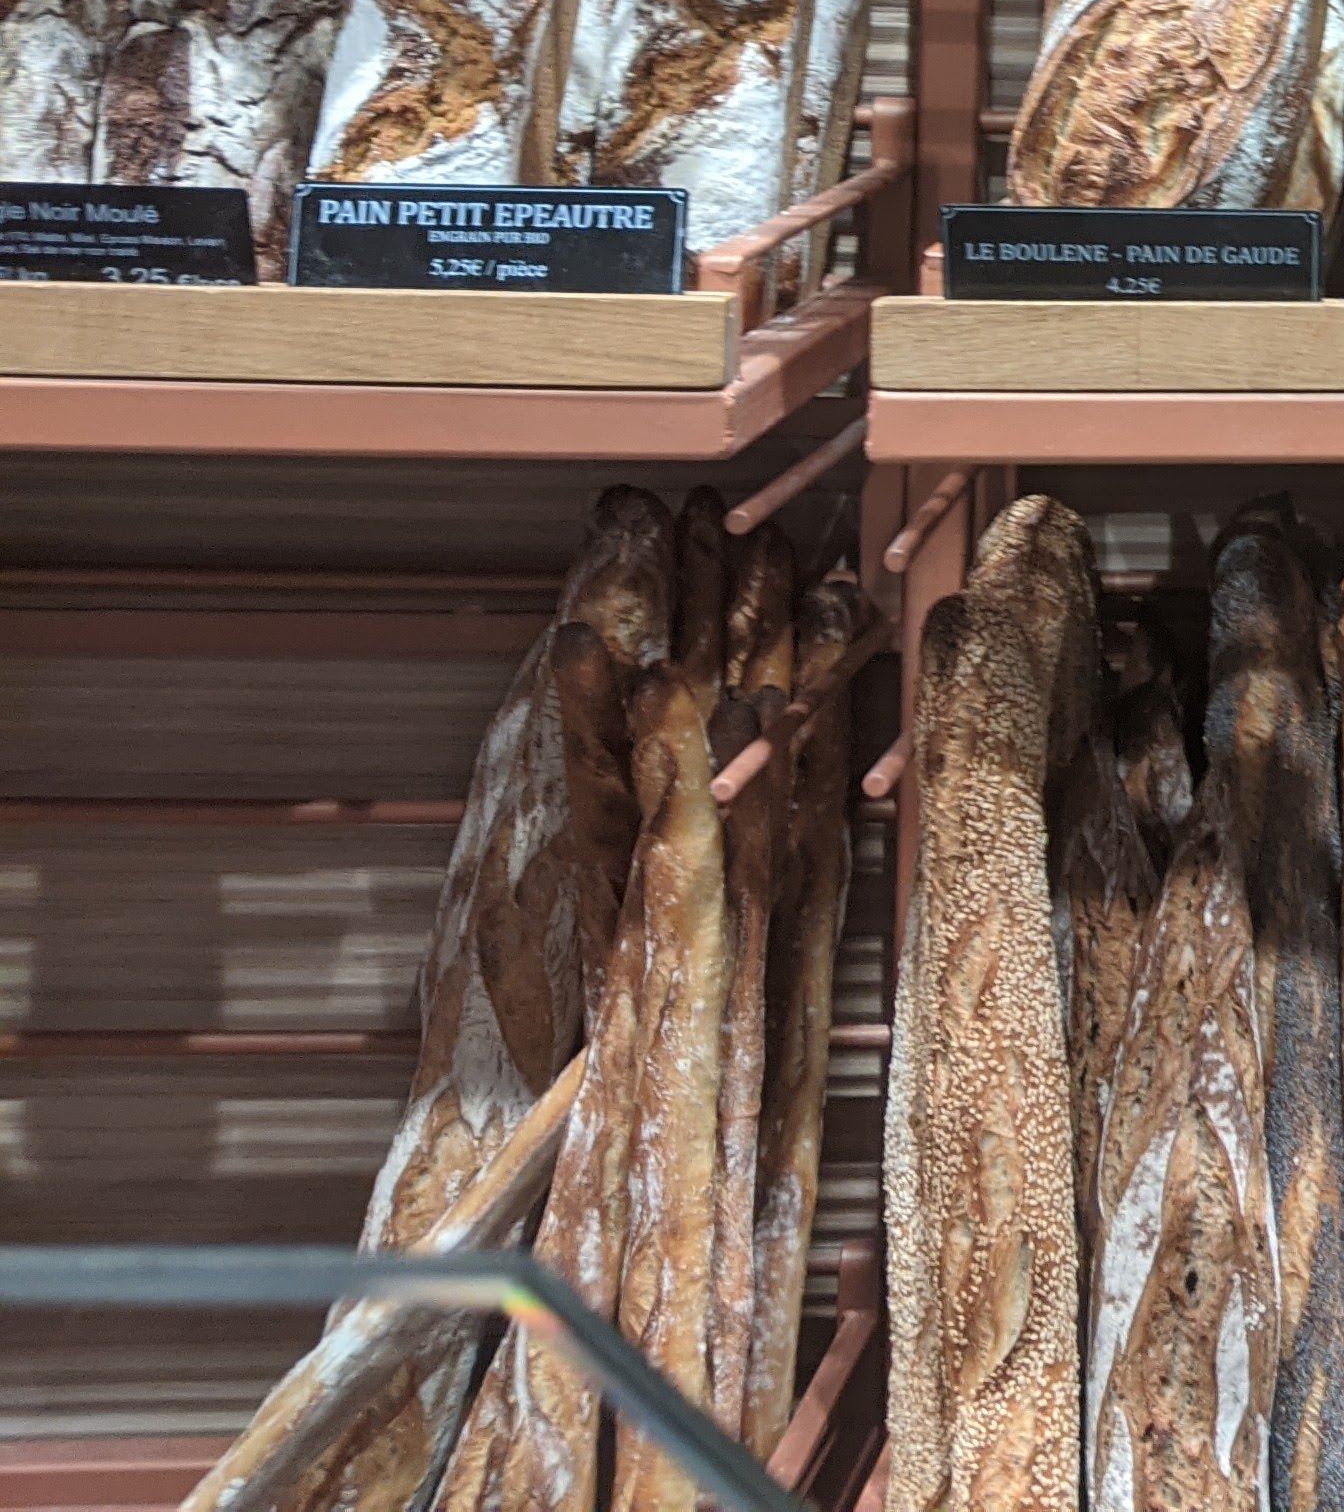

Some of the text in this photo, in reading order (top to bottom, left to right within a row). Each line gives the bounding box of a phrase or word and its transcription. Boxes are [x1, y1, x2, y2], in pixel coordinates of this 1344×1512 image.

[317, 198, 656, 230] PAIN PETIT EPEAUTRE
[963, 241, 996, 262] LE
[998, 241, 1109, 264] BOULENE
[1125, 244, 1184, 265] PAIN
[1184, 245, 1220, 266] DE
[1221, 245, 1301, 267] GAUDE
